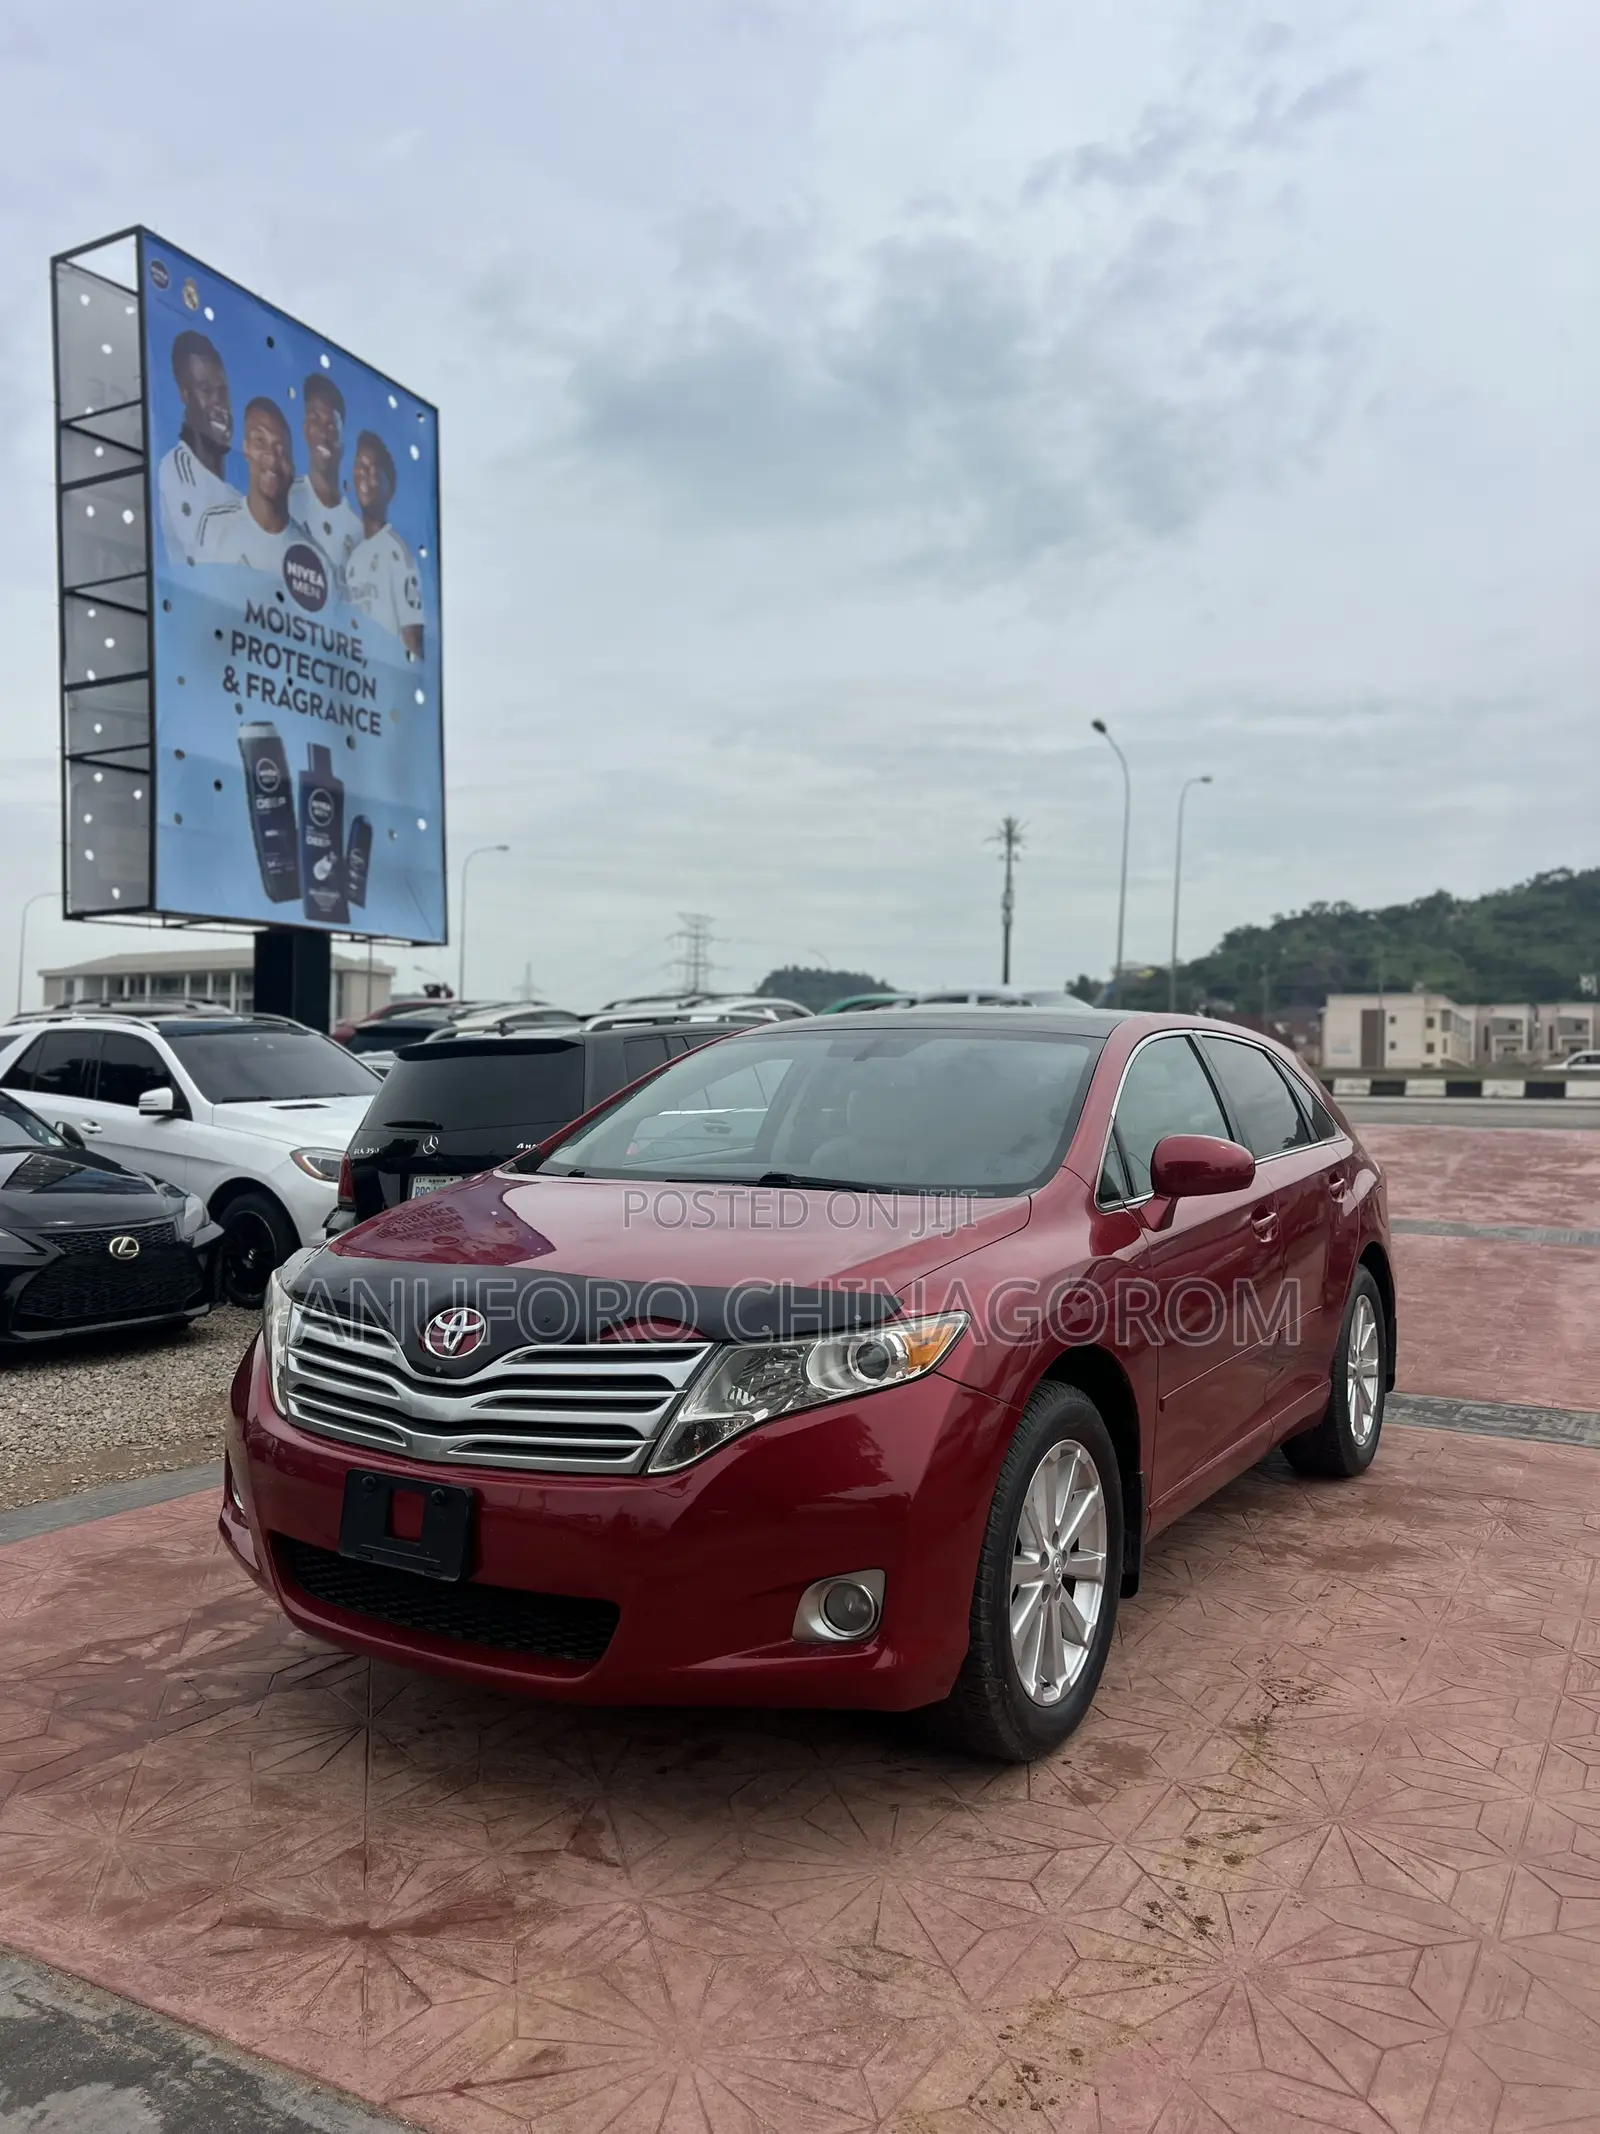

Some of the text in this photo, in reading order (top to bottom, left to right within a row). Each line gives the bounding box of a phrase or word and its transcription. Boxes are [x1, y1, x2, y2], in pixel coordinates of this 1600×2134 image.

[287, 561, 326, 588] NIVEA
[292, 577, 321, 600] MEN
[231, 629, 377, 700] PROTECTION
[244, 598, 369, 669] MOISTURE,
[222, 664, 382, 737] & FRAGRANCE
